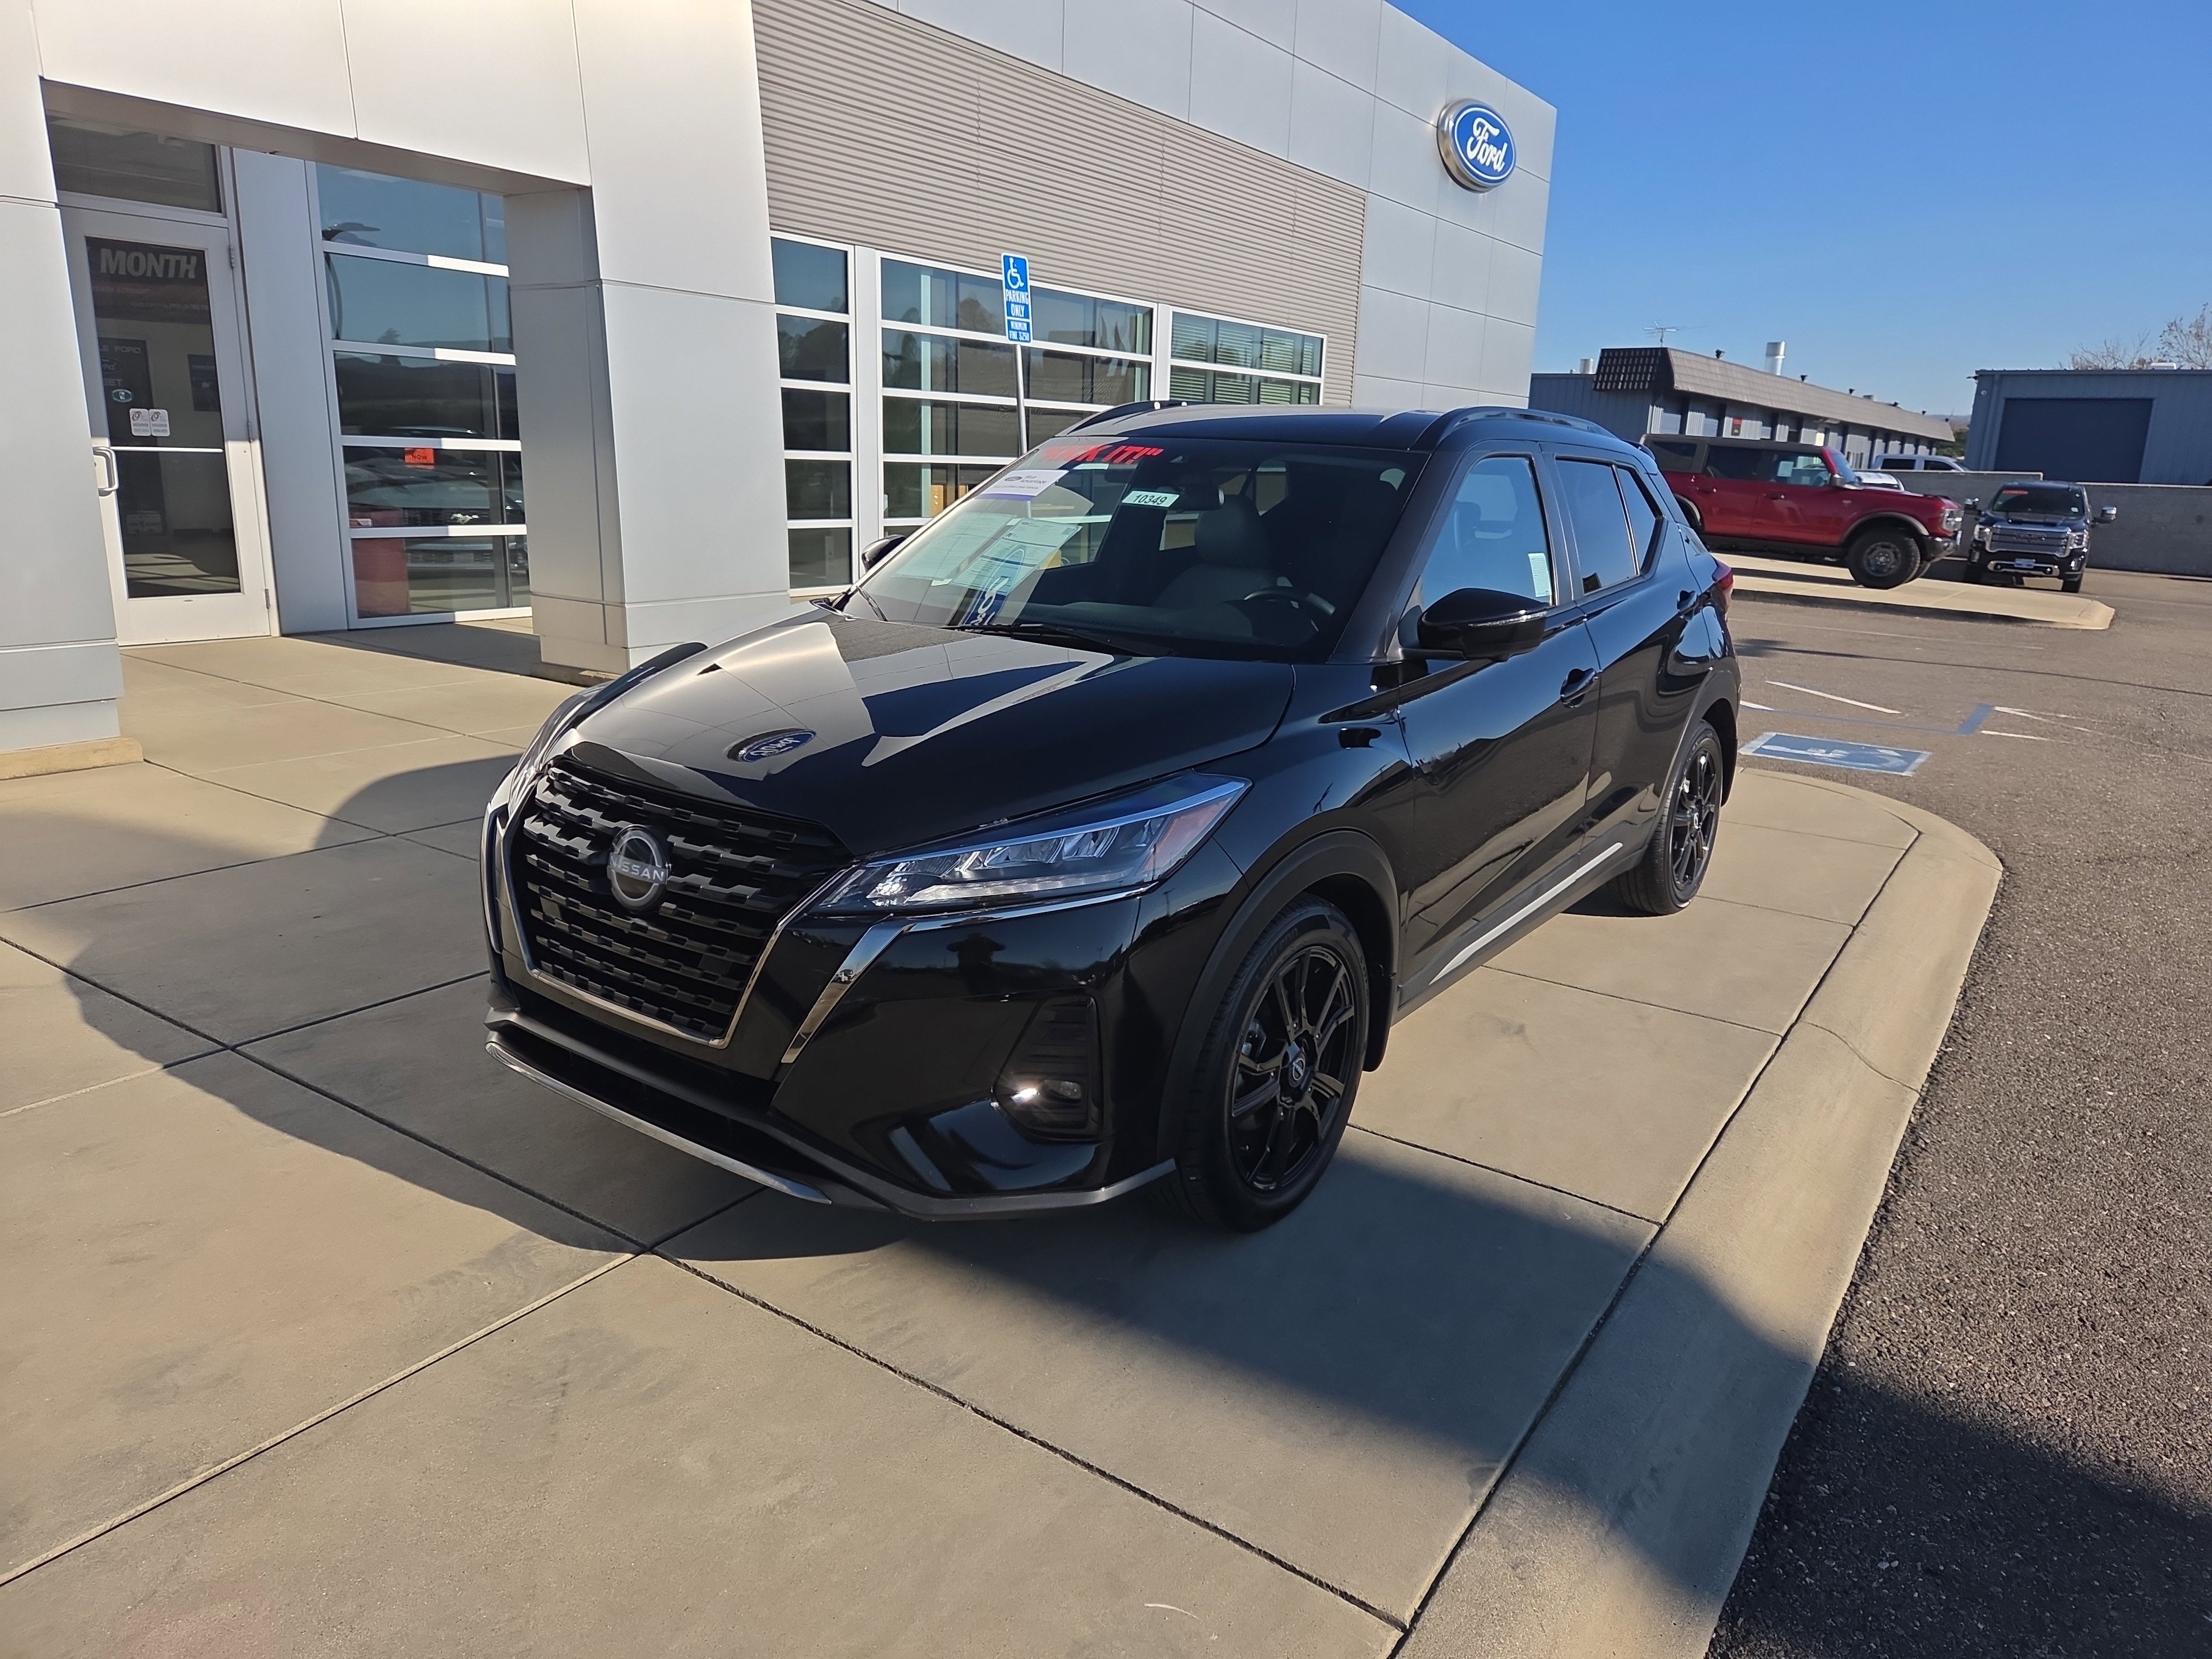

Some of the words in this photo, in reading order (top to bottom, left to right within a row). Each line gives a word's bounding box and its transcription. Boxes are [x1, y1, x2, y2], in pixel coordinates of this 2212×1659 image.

[1467, 117, 1508, 172] Ford
[100, 248, 197, 279] MONTH
[1006, 289, 1028, 305] PARKING
[1011, 304, 1025, 317] ONLY
[1133, 494, 1168, 505] 10349
[609, 855, 665, 882] NISSAN
